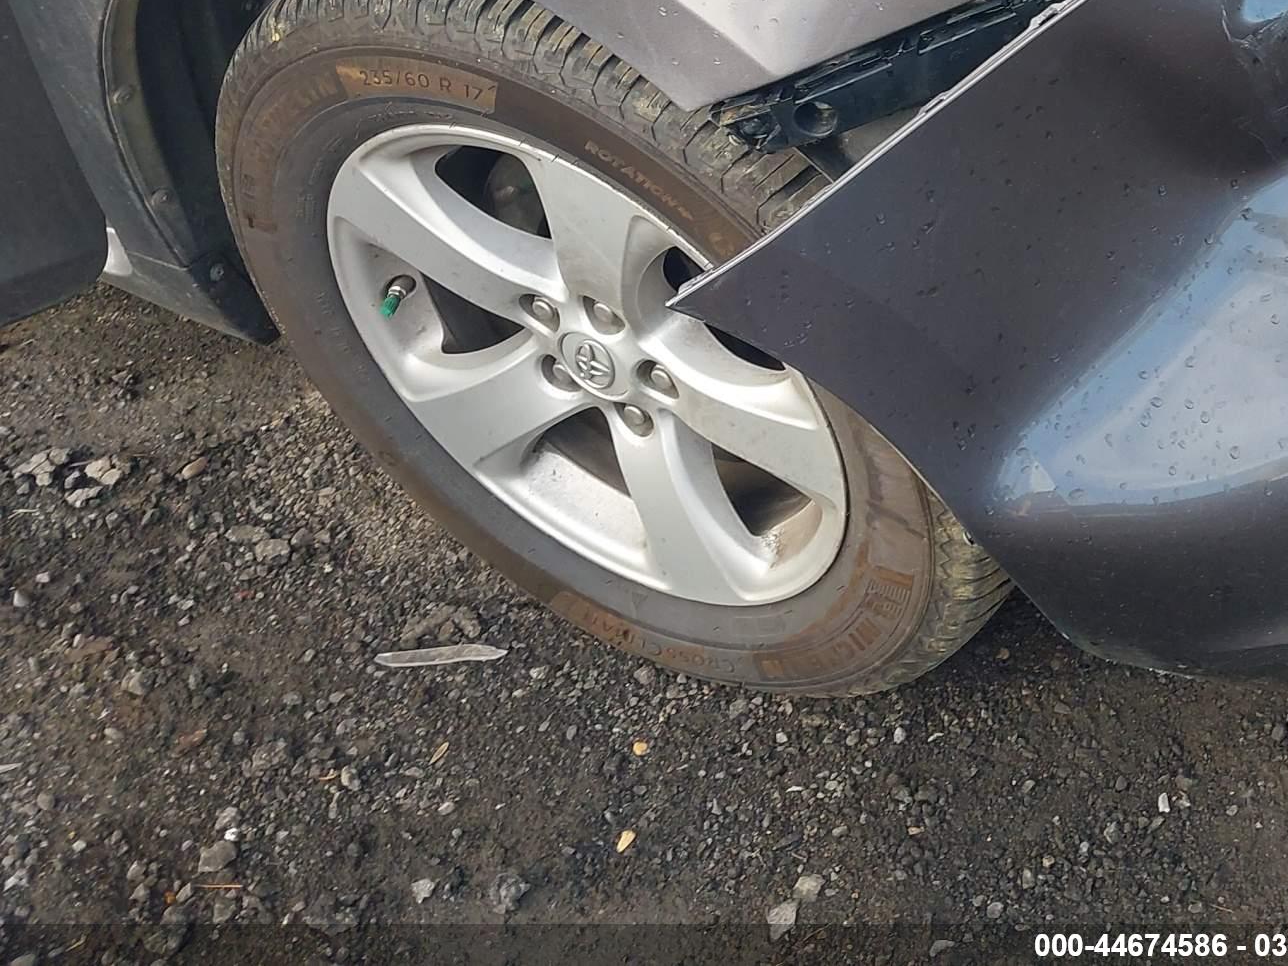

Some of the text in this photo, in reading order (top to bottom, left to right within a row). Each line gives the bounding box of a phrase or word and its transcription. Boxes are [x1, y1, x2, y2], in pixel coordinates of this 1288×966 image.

[359, 68, 430, 89] 235/60
[439, 76, 452, 92] R
[584, 139, 677, 206] ROTATION
